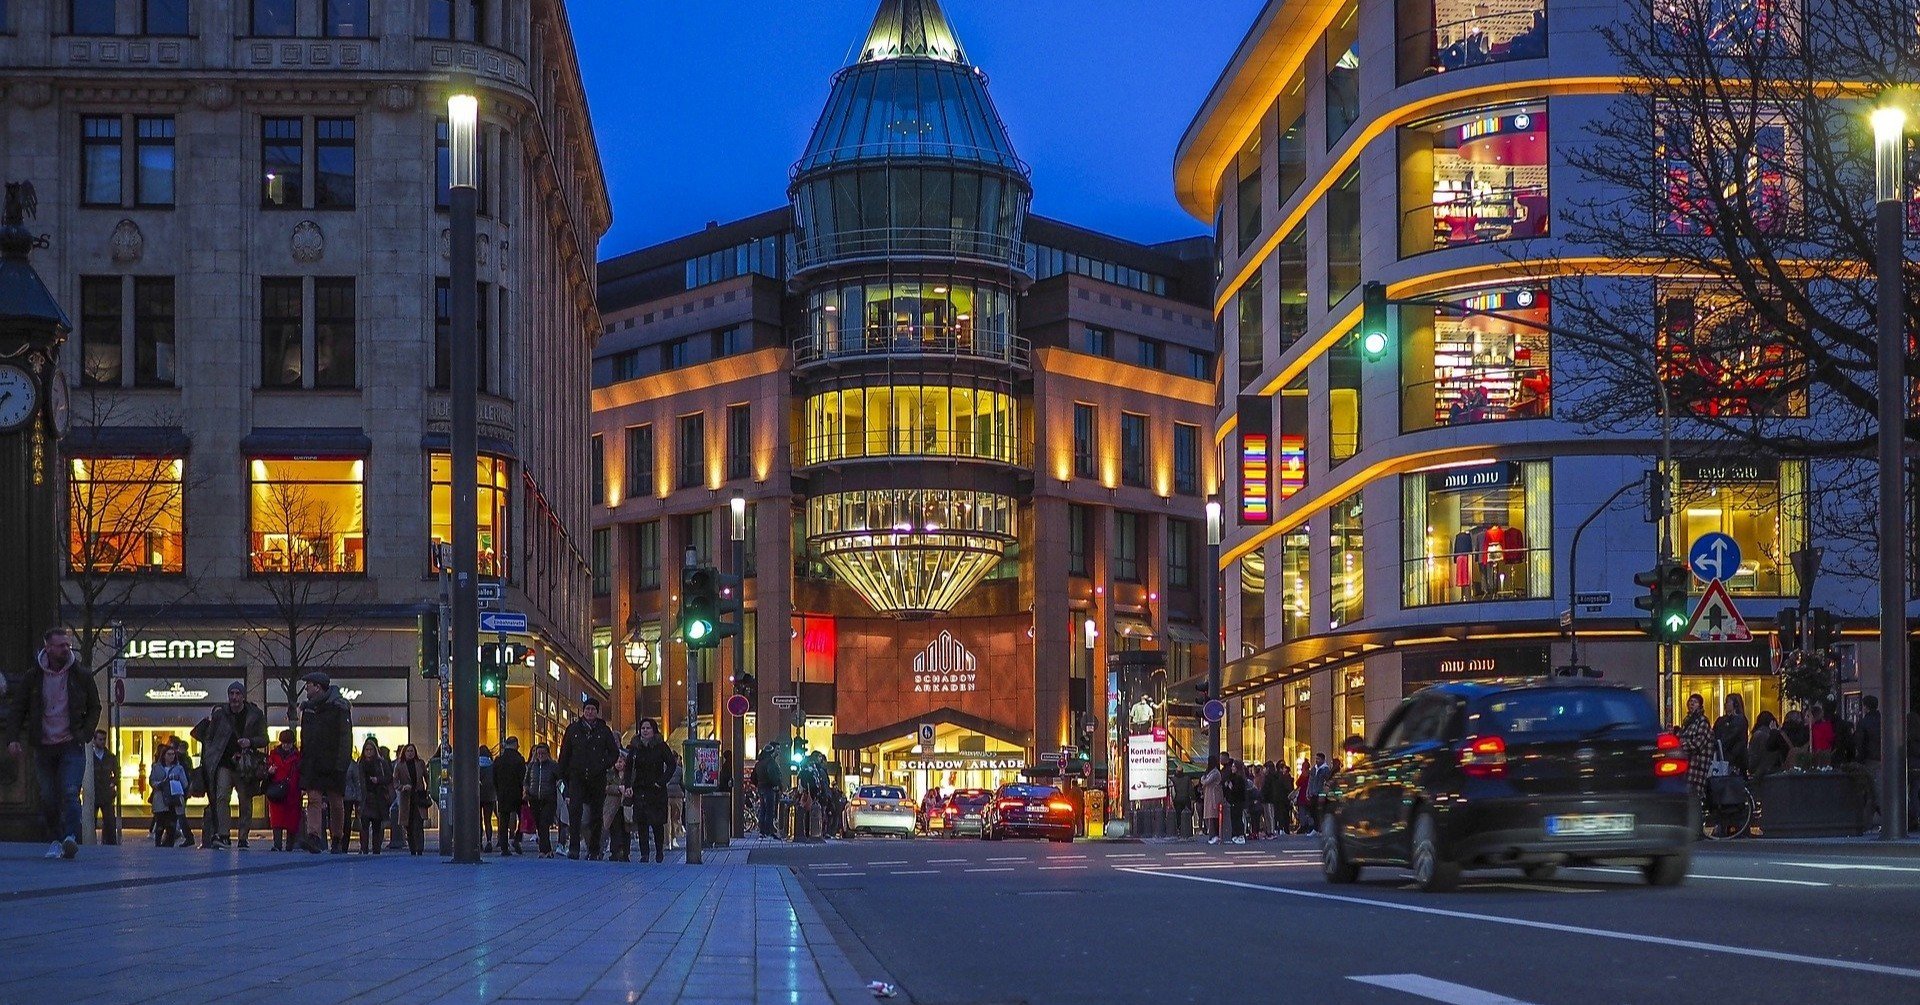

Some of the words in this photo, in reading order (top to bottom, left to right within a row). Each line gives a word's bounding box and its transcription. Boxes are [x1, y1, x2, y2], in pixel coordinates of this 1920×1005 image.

[914, 674, 976, 683] SCHADOW
[914, 684, 976, 692] ARKADEN
[900, 760, 962, 769] SCHADOW
[970, 760, 1025, 769] ARKADE
